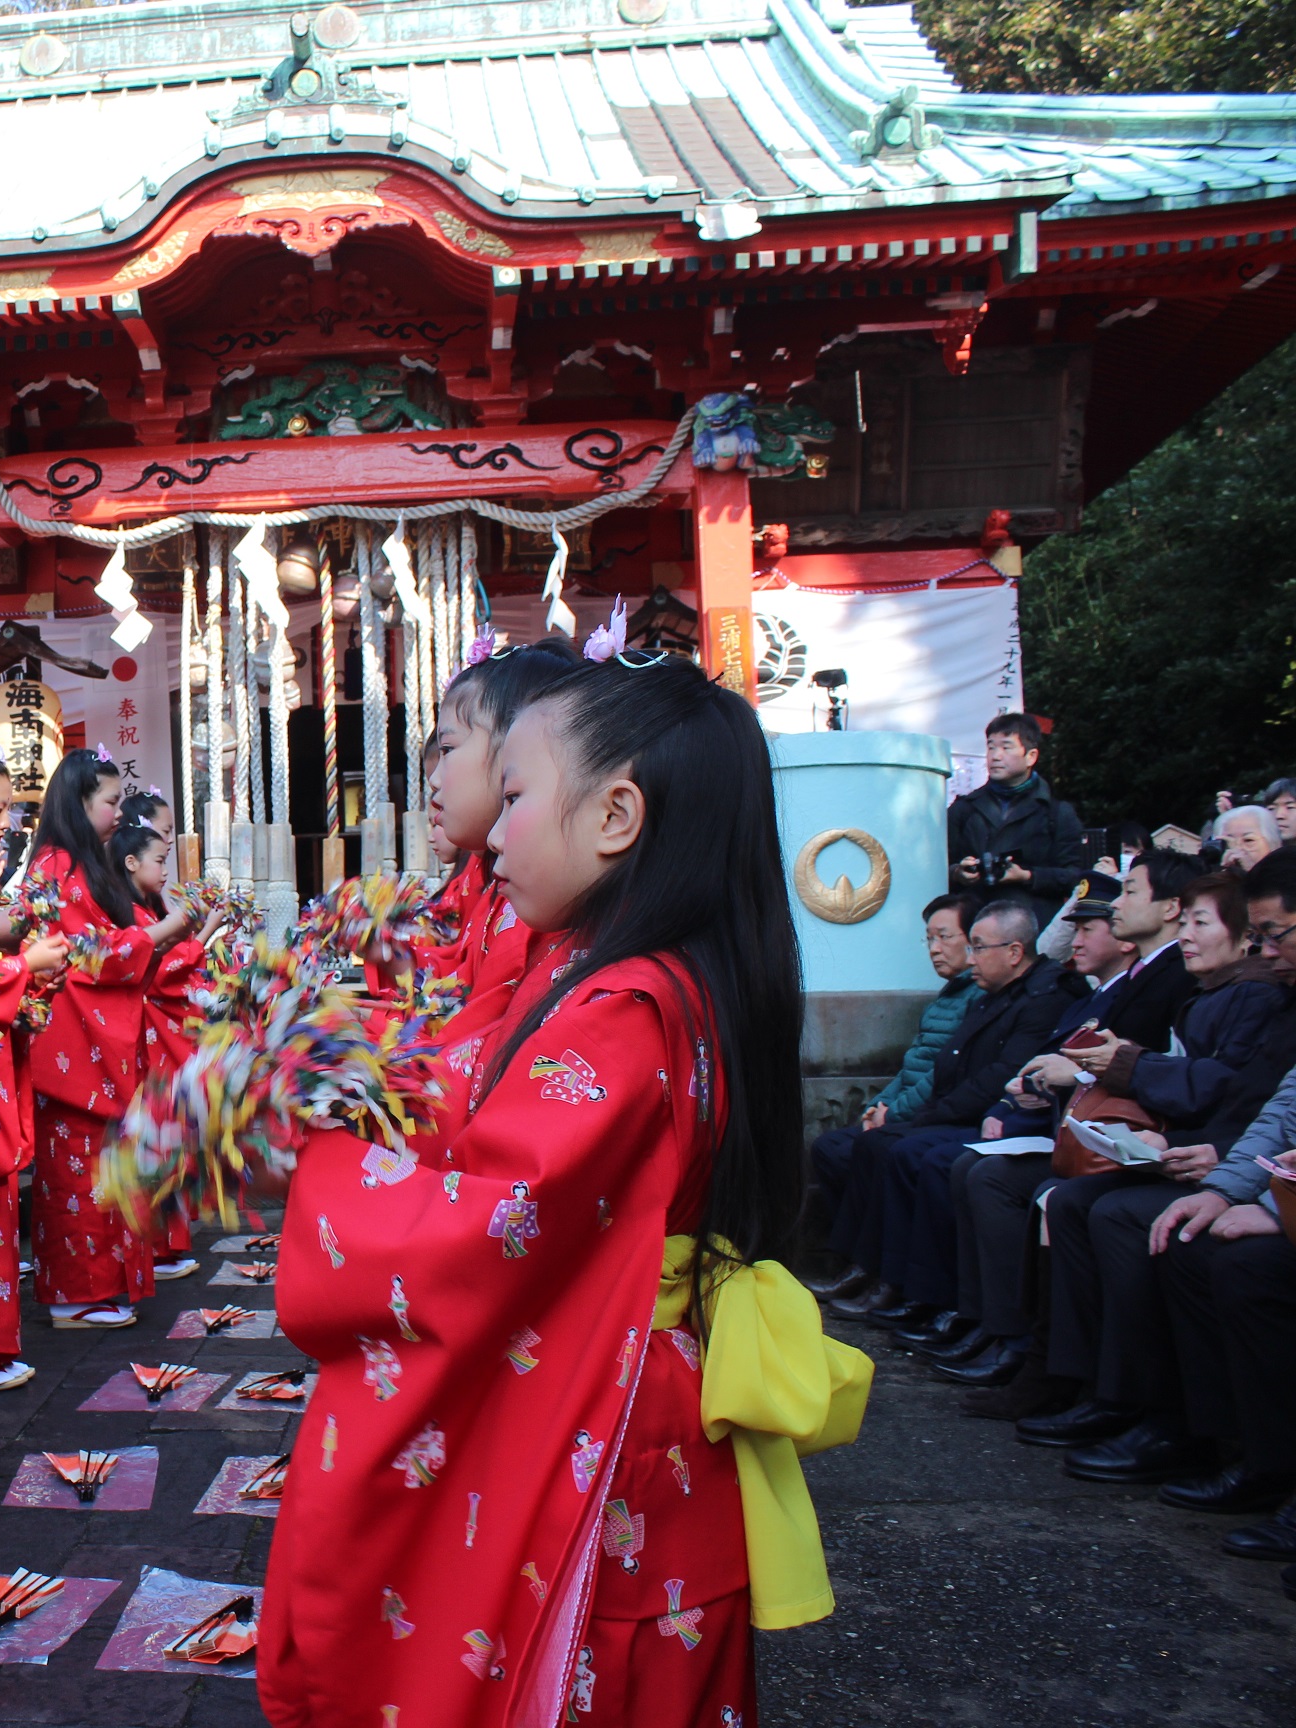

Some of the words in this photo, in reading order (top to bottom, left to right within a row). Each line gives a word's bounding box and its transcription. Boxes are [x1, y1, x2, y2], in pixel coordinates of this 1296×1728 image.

[5, 682, 45, 792] 海南神社
[116, 698, 140, 747] 奉祝
